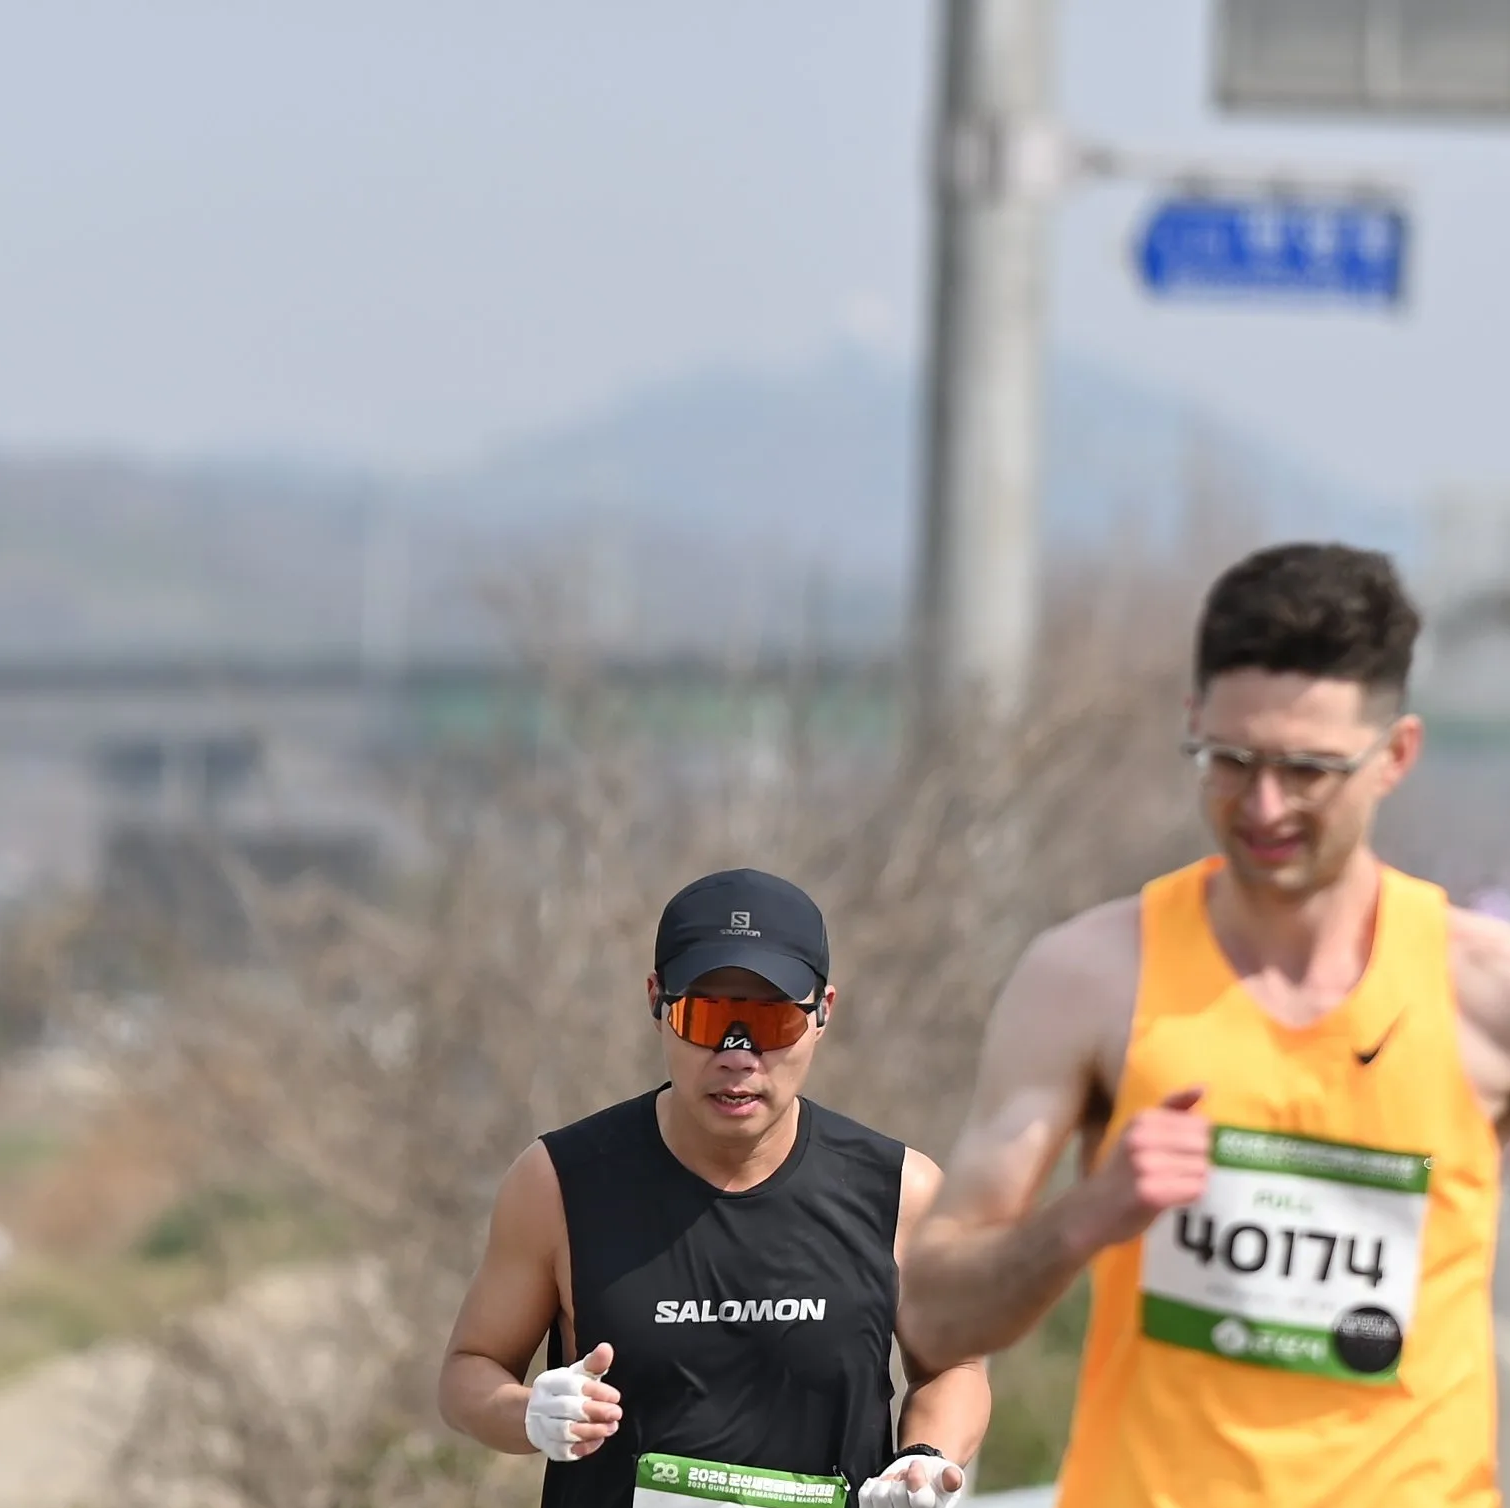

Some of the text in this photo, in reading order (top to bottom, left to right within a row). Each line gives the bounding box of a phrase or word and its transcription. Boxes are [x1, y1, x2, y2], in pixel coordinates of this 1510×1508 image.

[1174, 1211, 1384, 1288] 40174
[654, 1299, 827, 1324] SALOMON
[688, 1467, 728, 1485] 2026
